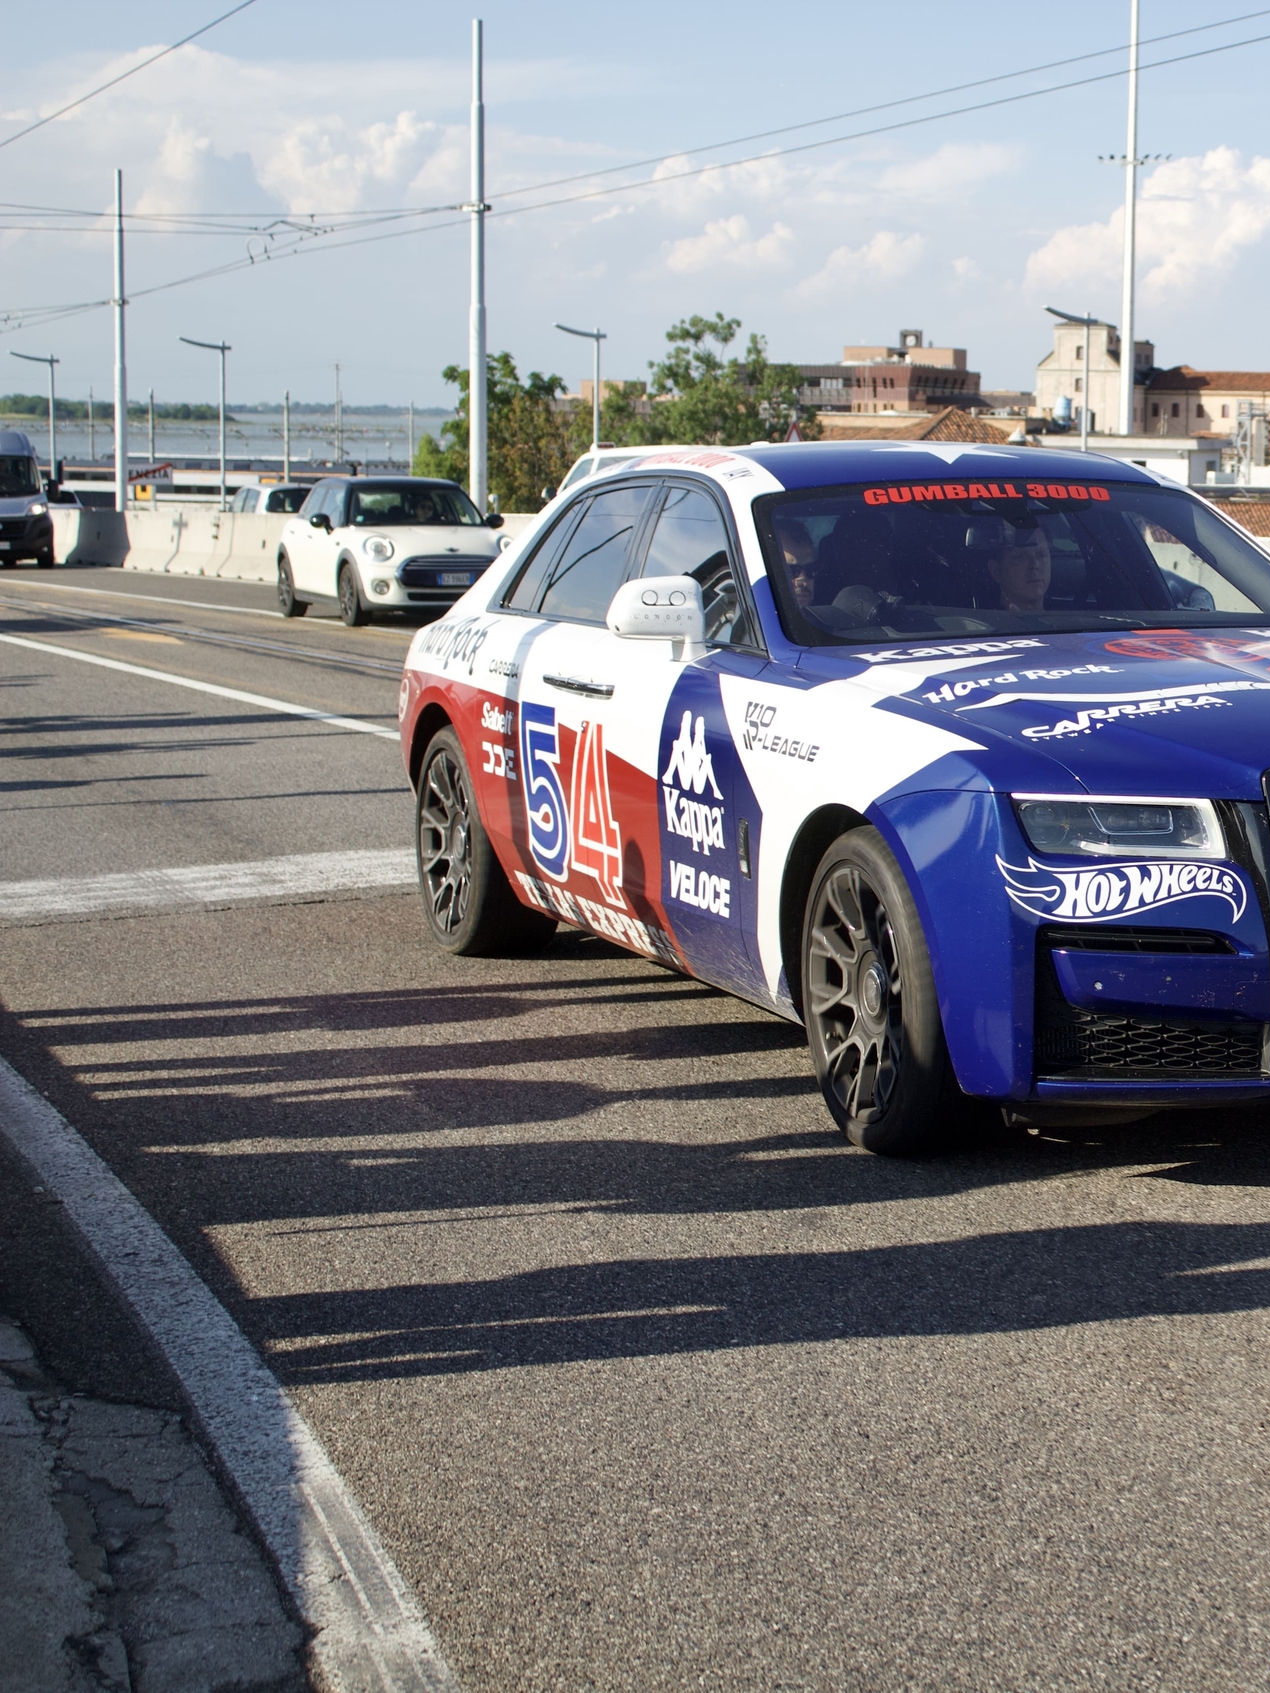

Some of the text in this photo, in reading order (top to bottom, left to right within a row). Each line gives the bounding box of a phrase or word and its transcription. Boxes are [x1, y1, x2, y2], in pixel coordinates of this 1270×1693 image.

[128, 468, 169, 479] ENEZIA
[863, 483, 1111, 506] GUMBALL 3000
[489, 659, 520, 679] CARRERA
[850, 638, 1049, 663] Kappa
[922, 664, 1118, 705] Hard Rock
[482, 701, 513, 736] Sabelt
[1021, 695, 1228, 737] CARRERA
[520, 701, 628, 910] 54
[662, 786, 725, 856] Kappa
[669, 860, 730, 918] VELOCE
[514, 870, 684, 967] TEXAS EXPRESS
